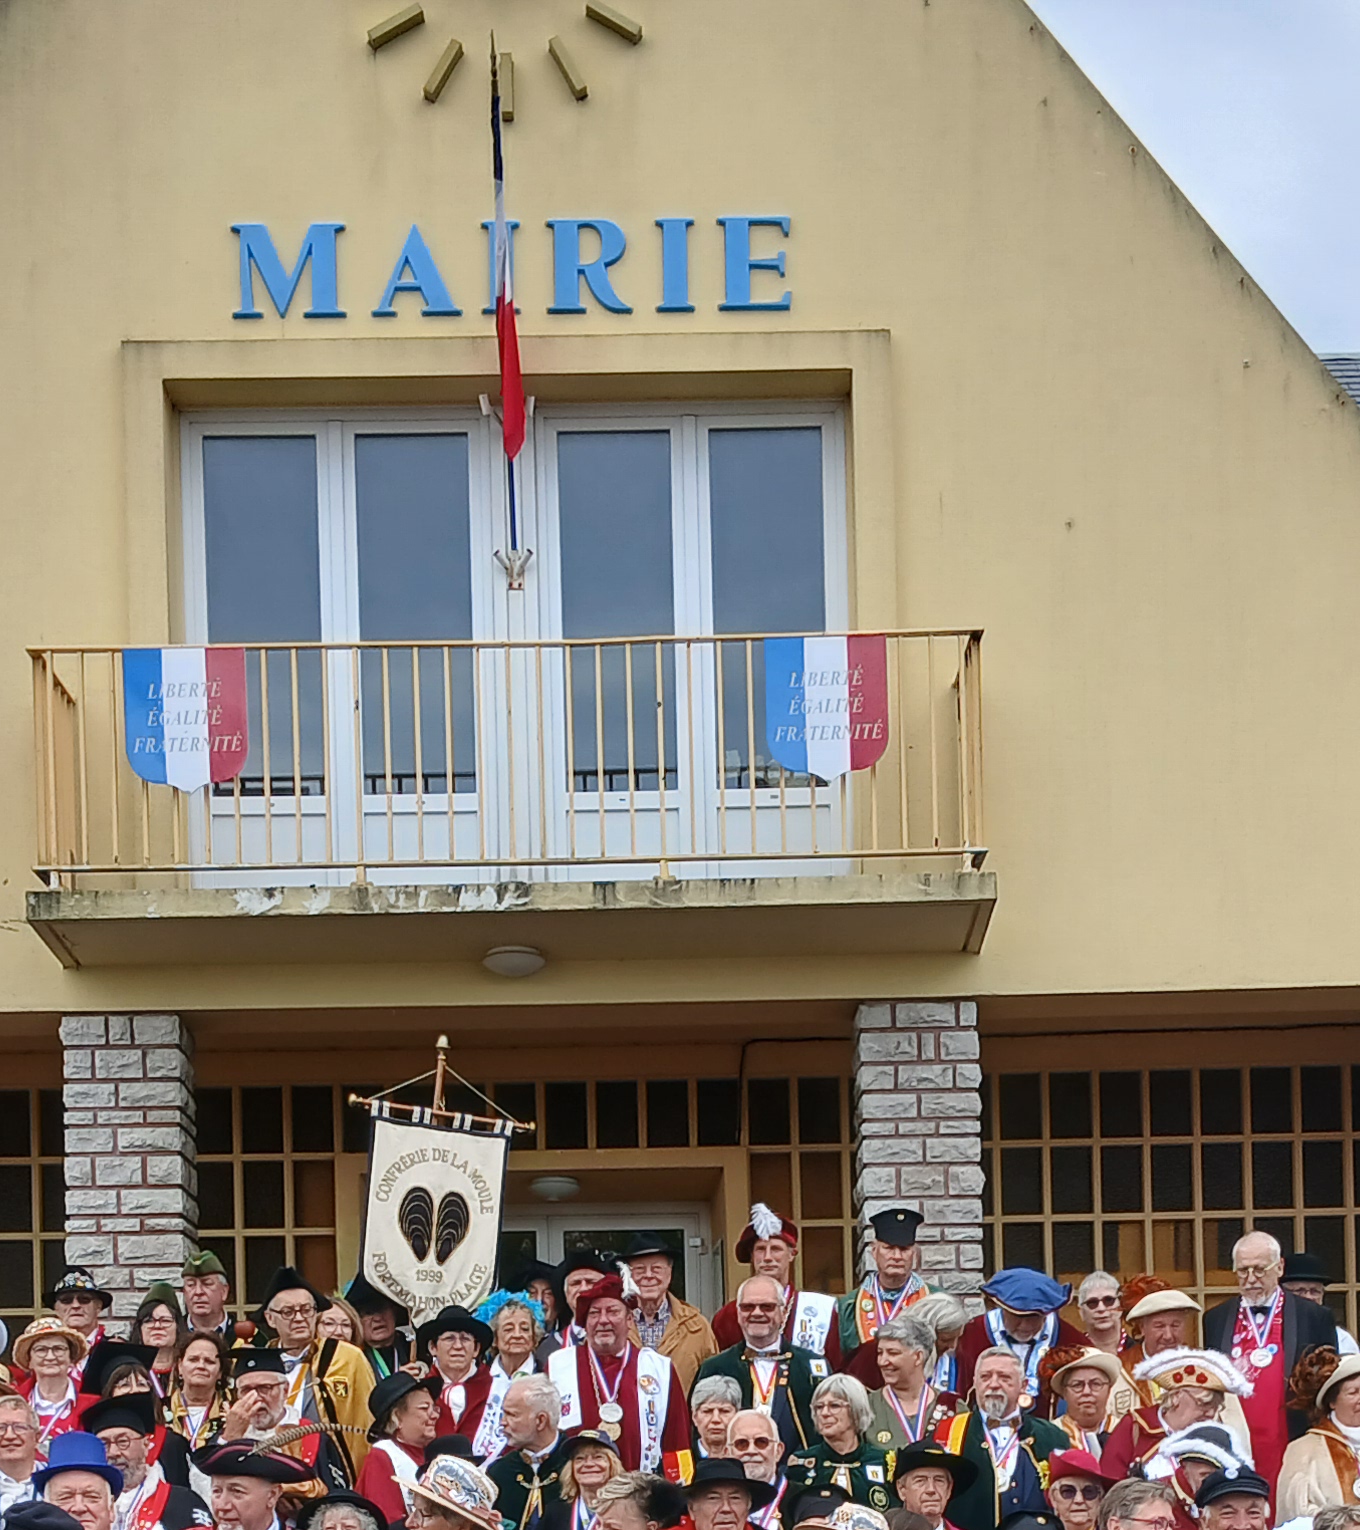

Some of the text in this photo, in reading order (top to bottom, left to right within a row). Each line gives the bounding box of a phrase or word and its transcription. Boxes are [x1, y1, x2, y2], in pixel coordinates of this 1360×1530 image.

[231, 215, 793, 319] MAIRIE
[789, 664, 864, 688] LIBERTÉ
[147, 677, 223, 700] LIBERTÉ
[789, 693, 864, 715] ÉGALITÉ
[147, 705, 223, 727] ÉGALITÉ
[775, 719, 884, 742] FRATERNITÉ
[133, 731, 244, 754] FRATERNITÉ
[432, 1148, 451, 1163] DE
[450, 1152, 469, 1174] LA
[467, 1168, 495, 1215] MOULE
[415, 1269, 444, 1284] 1999
